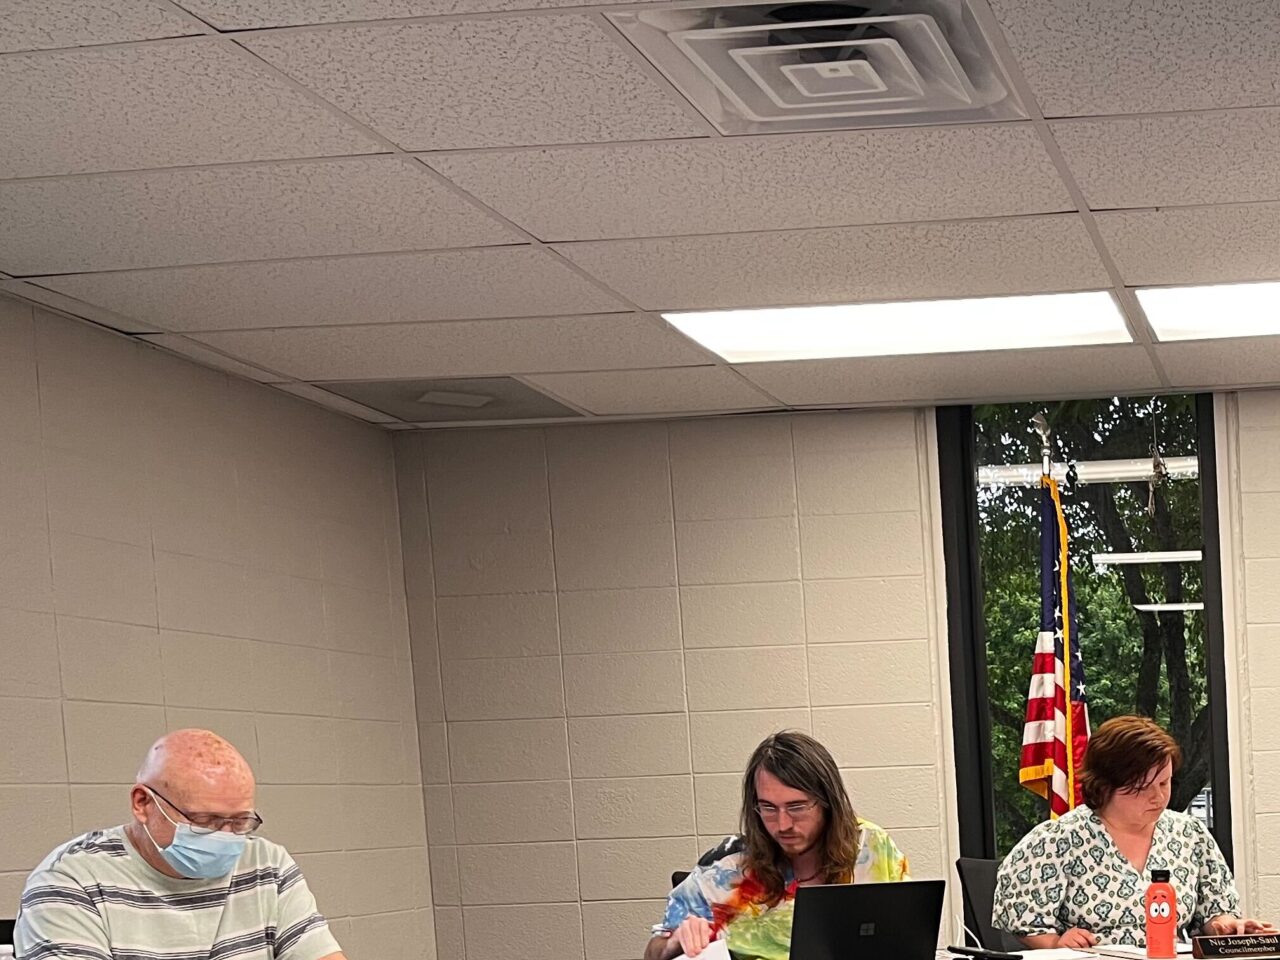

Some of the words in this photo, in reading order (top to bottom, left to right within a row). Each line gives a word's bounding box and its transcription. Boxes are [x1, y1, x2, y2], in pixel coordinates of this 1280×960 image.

[1208, 938, 1226, 946] Nic
[1228, 936, 1279, 946] Joseph-Saul
[1218, 945, 1276, 954] Councilmember
